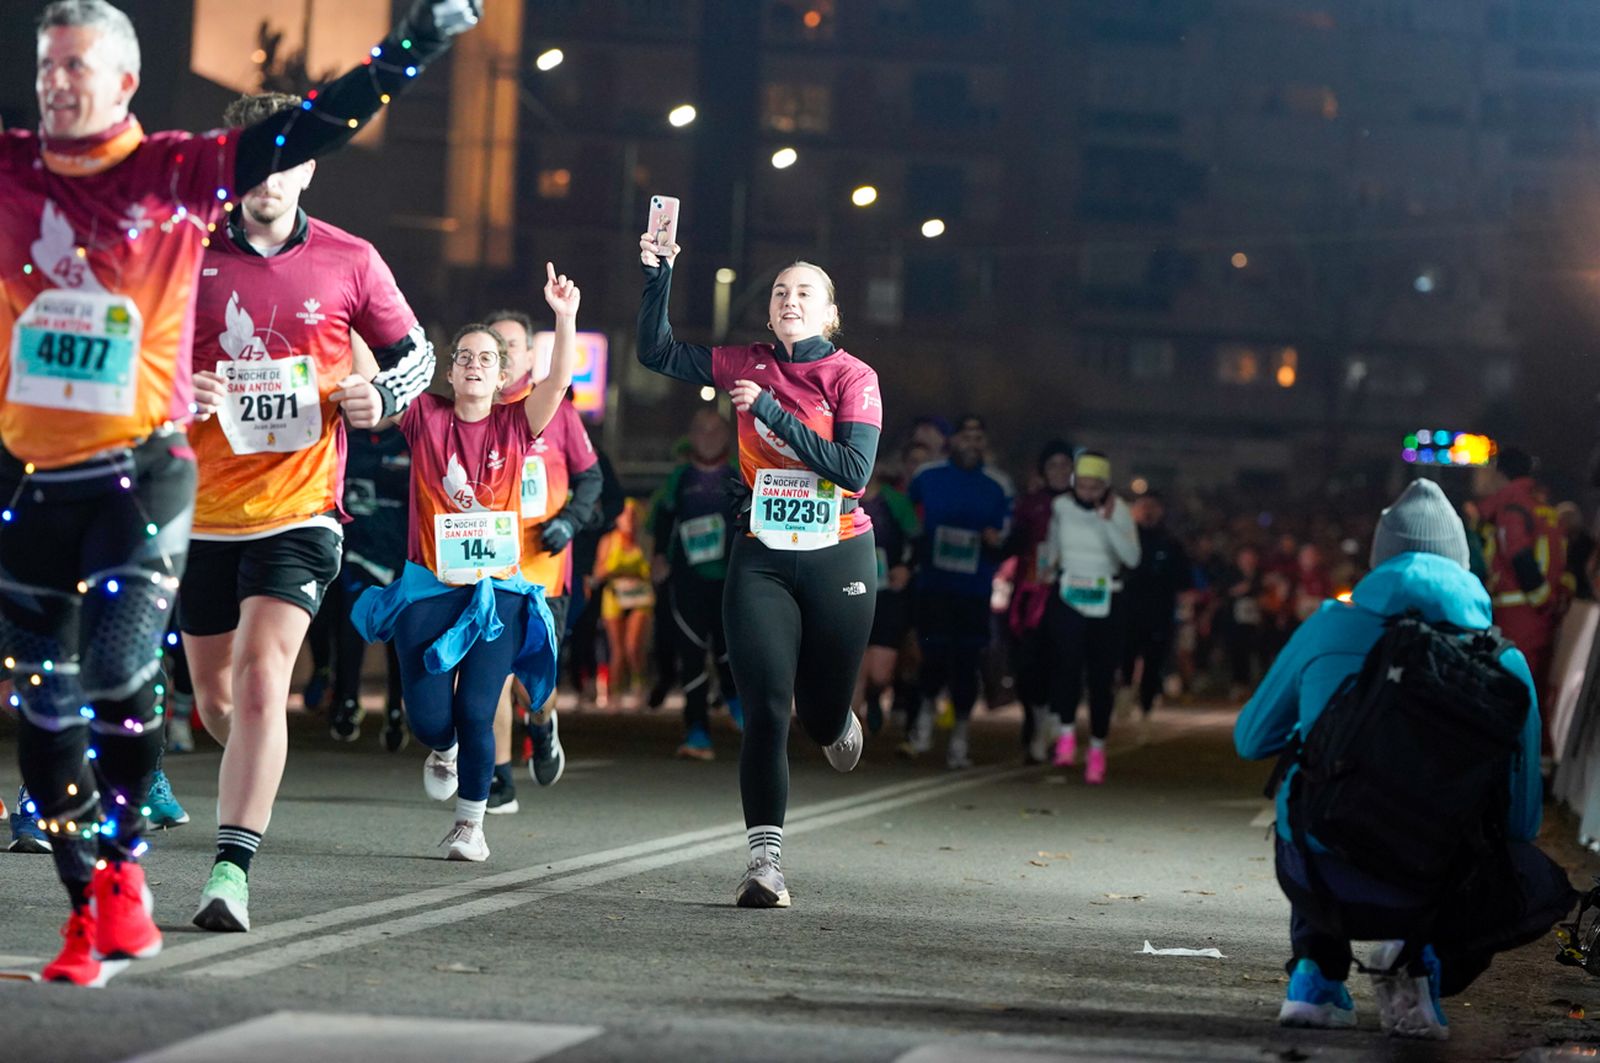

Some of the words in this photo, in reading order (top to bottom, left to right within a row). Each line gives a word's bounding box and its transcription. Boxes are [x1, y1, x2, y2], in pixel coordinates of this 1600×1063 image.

[37, 331, 110, 370] 4877
[238, 371, 266, 380] NOCHE
[269, 371, 281, 379] DE
[227, 383, 246, 393] SAN
[239, 392, 298, 422] 2671
[772, 479, 798, 488] NOCHE
[799, 480, 810, 488] DE
[762, 487, 780, 497] SAN
[453, 489, 473, 509] 43
[762, 497, 830, 525] 13239
[453, 521, 477, 529] NOCHE
[445, 530, 461, 539] SAN
[461, 539, 496, 560] 144
